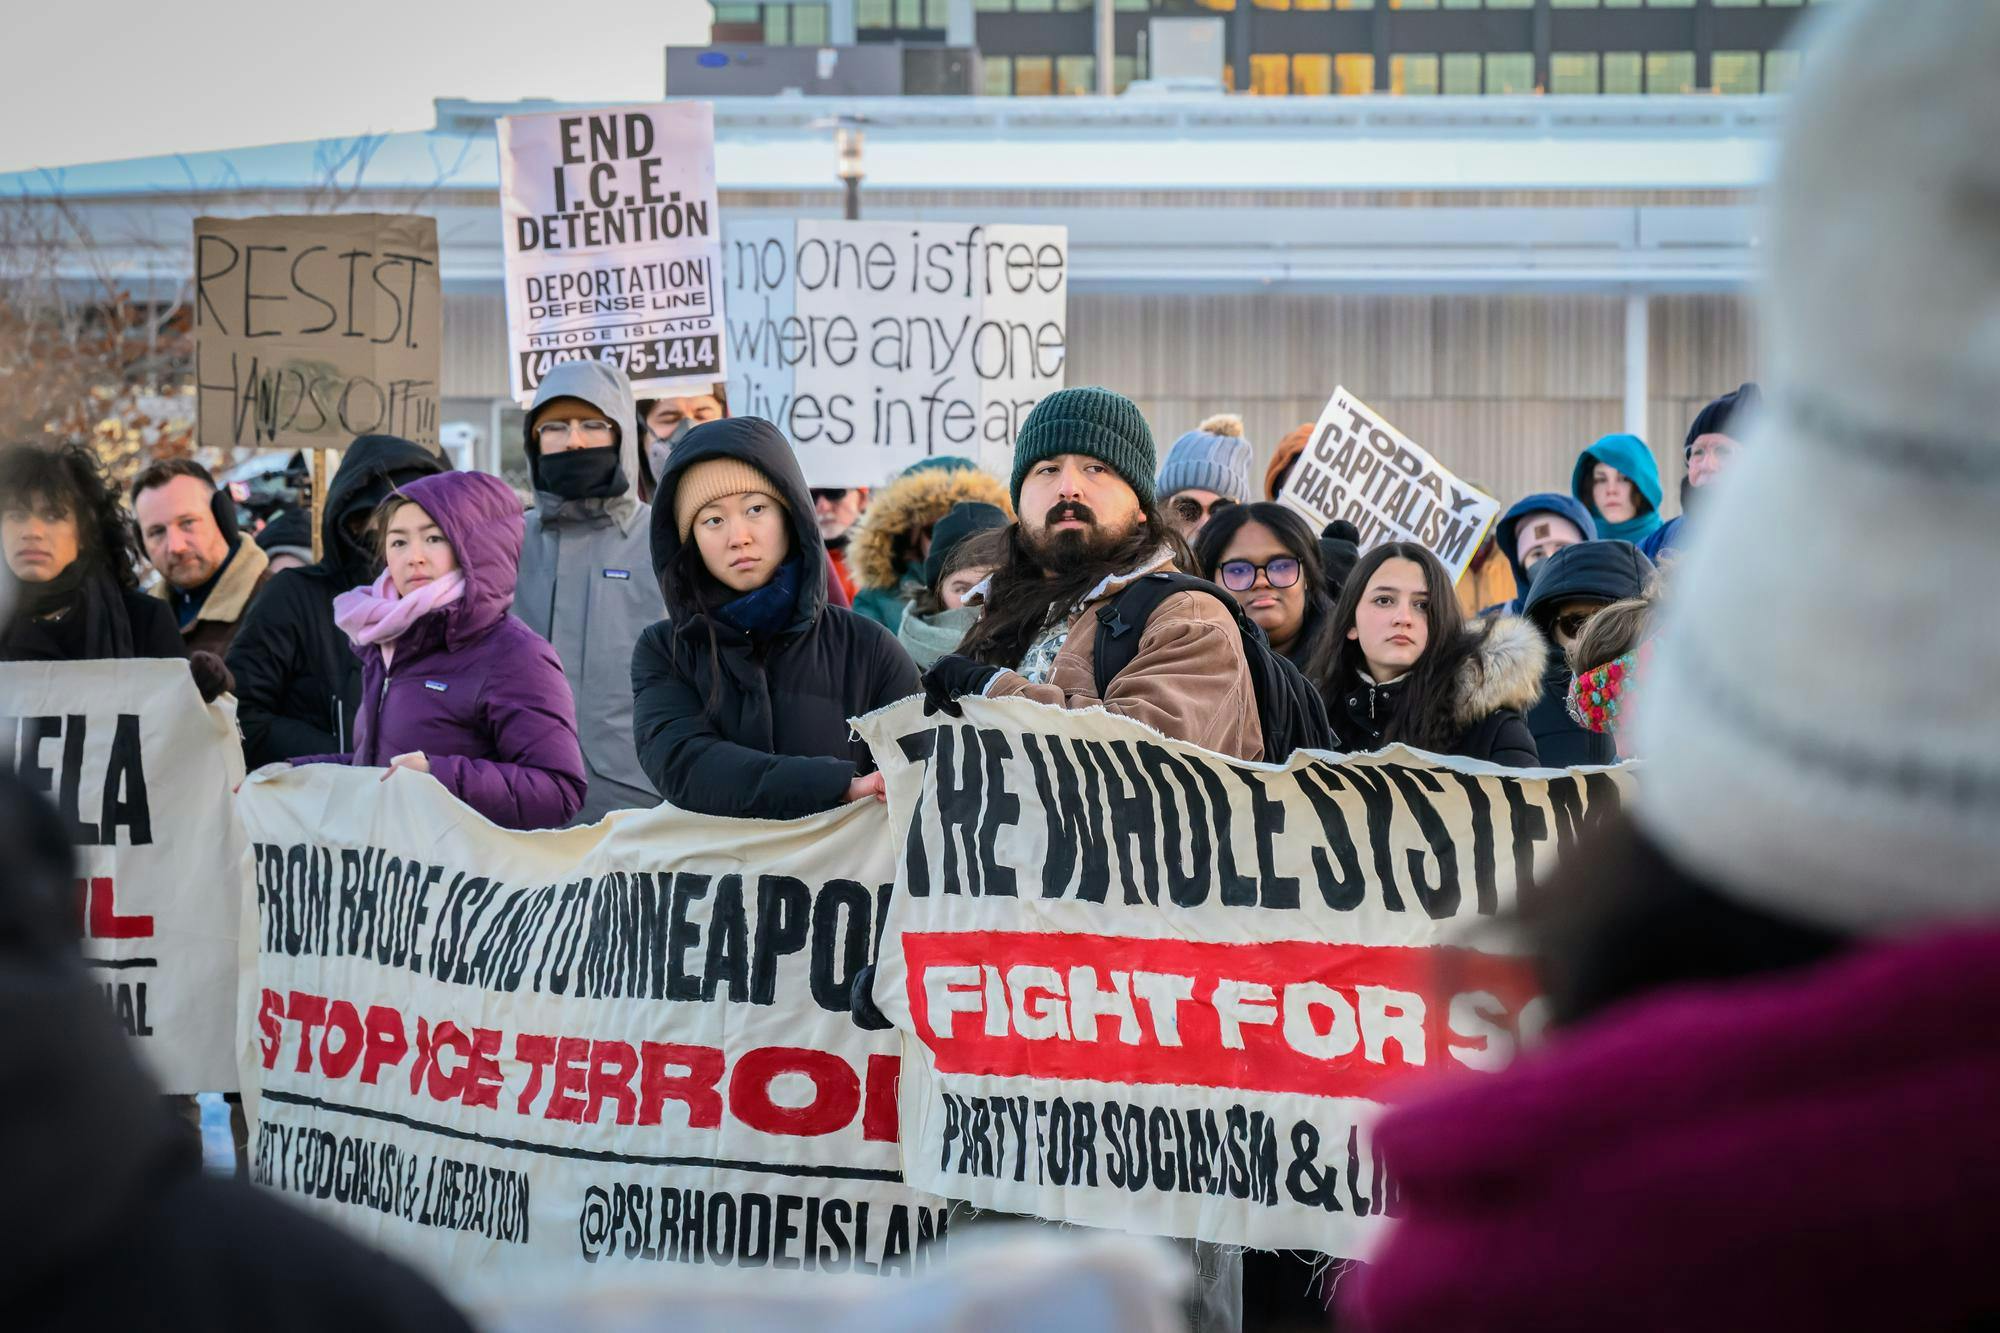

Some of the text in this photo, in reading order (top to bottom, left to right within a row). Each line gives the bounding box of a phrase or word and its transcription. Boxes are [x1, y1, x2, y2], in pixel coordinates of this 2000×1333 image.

[560, 113, 655, 165] END
[517, 202, 709, 251] DETENTION
[554, 158, 681, 212] I.C.E.
[197, 235, 433, 348] RESIST.
[526, 259, 704, 303] DEPORTATION
[735, 226, 1064, 298] no one is free
[530, 292, 706, 319] DEFENSE LINE
[530, 319, 711, 348] RHODE ISLAND
[727, 295, 1066, 380] where anyone
[197, 340, 327, 446] HANDS
[600, 337, 715, 374] 675-1414
[743, 373, 1036, 456] lives in fear
[1293, 462, 1347, 520] HAS
[1313, 422, 1477, 566] CAPITALISM
[0, 714, 153, 845] ELA
[896, 725, 1020, 898] THE
[1021, 732, 1301, 910] WHOLE
[253, 843, 333, 957] FROM
[337, 846, 445, 974] RHODE
[428, 871, 556, 993] ISLAND
[533, 877, 593, 995] TO
[258, 988, 408, 1085] STOP
[410, 1016, 504, 1110] ICE
[923, 965, 1197, 1048] FIGHT
[1211, 977, 1428, 1067] FOR
[940, 1092, 1030, 1182] PARTY
[1034, 1096, 1099, 1188] FOR
[1100, 1099, 1279, 1208] SOCIALISM
[1285, 1119, 1344, 1213] &
[403, 1154, 420, 1223] &
[418, 1155, 531, 1244] LIBERATION
